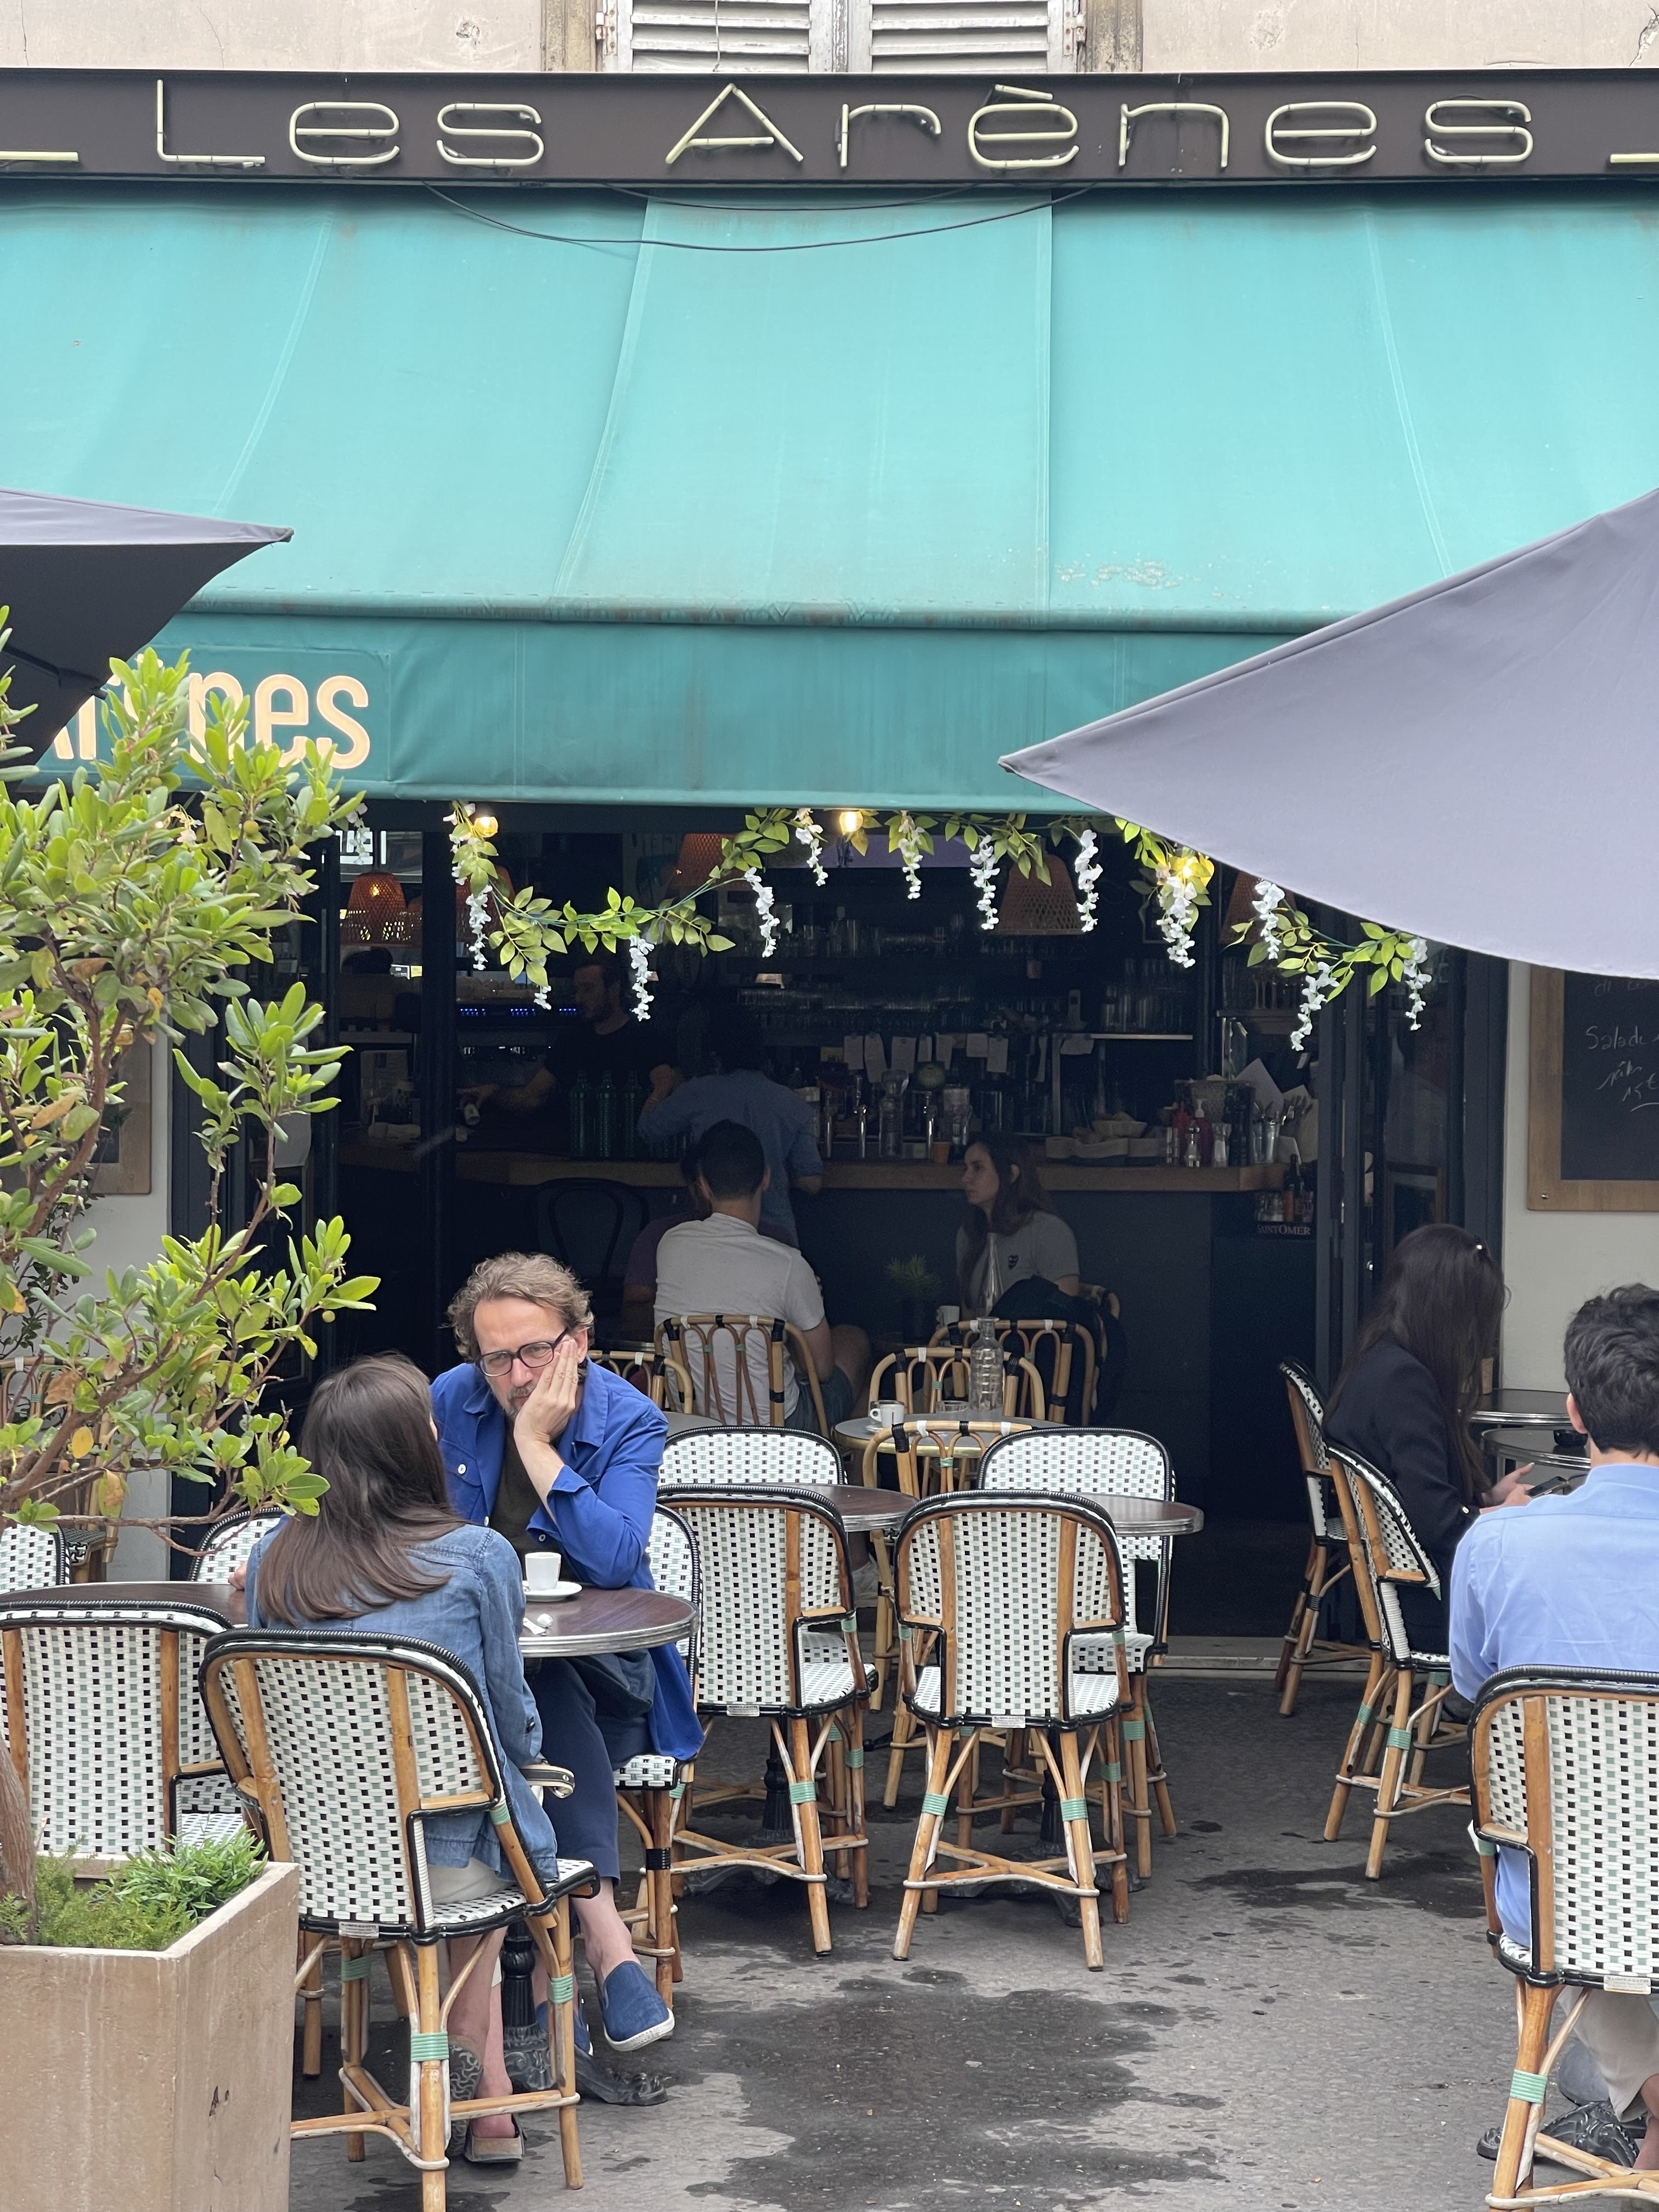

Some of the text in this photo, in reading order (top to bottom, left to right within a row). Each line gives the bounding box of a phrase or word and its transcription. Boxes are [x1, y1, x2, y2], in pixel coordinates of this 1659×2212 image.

[156, 78, 1533, 168] Les Arènes
[1586, 1025, 1647, 1049] Salade
